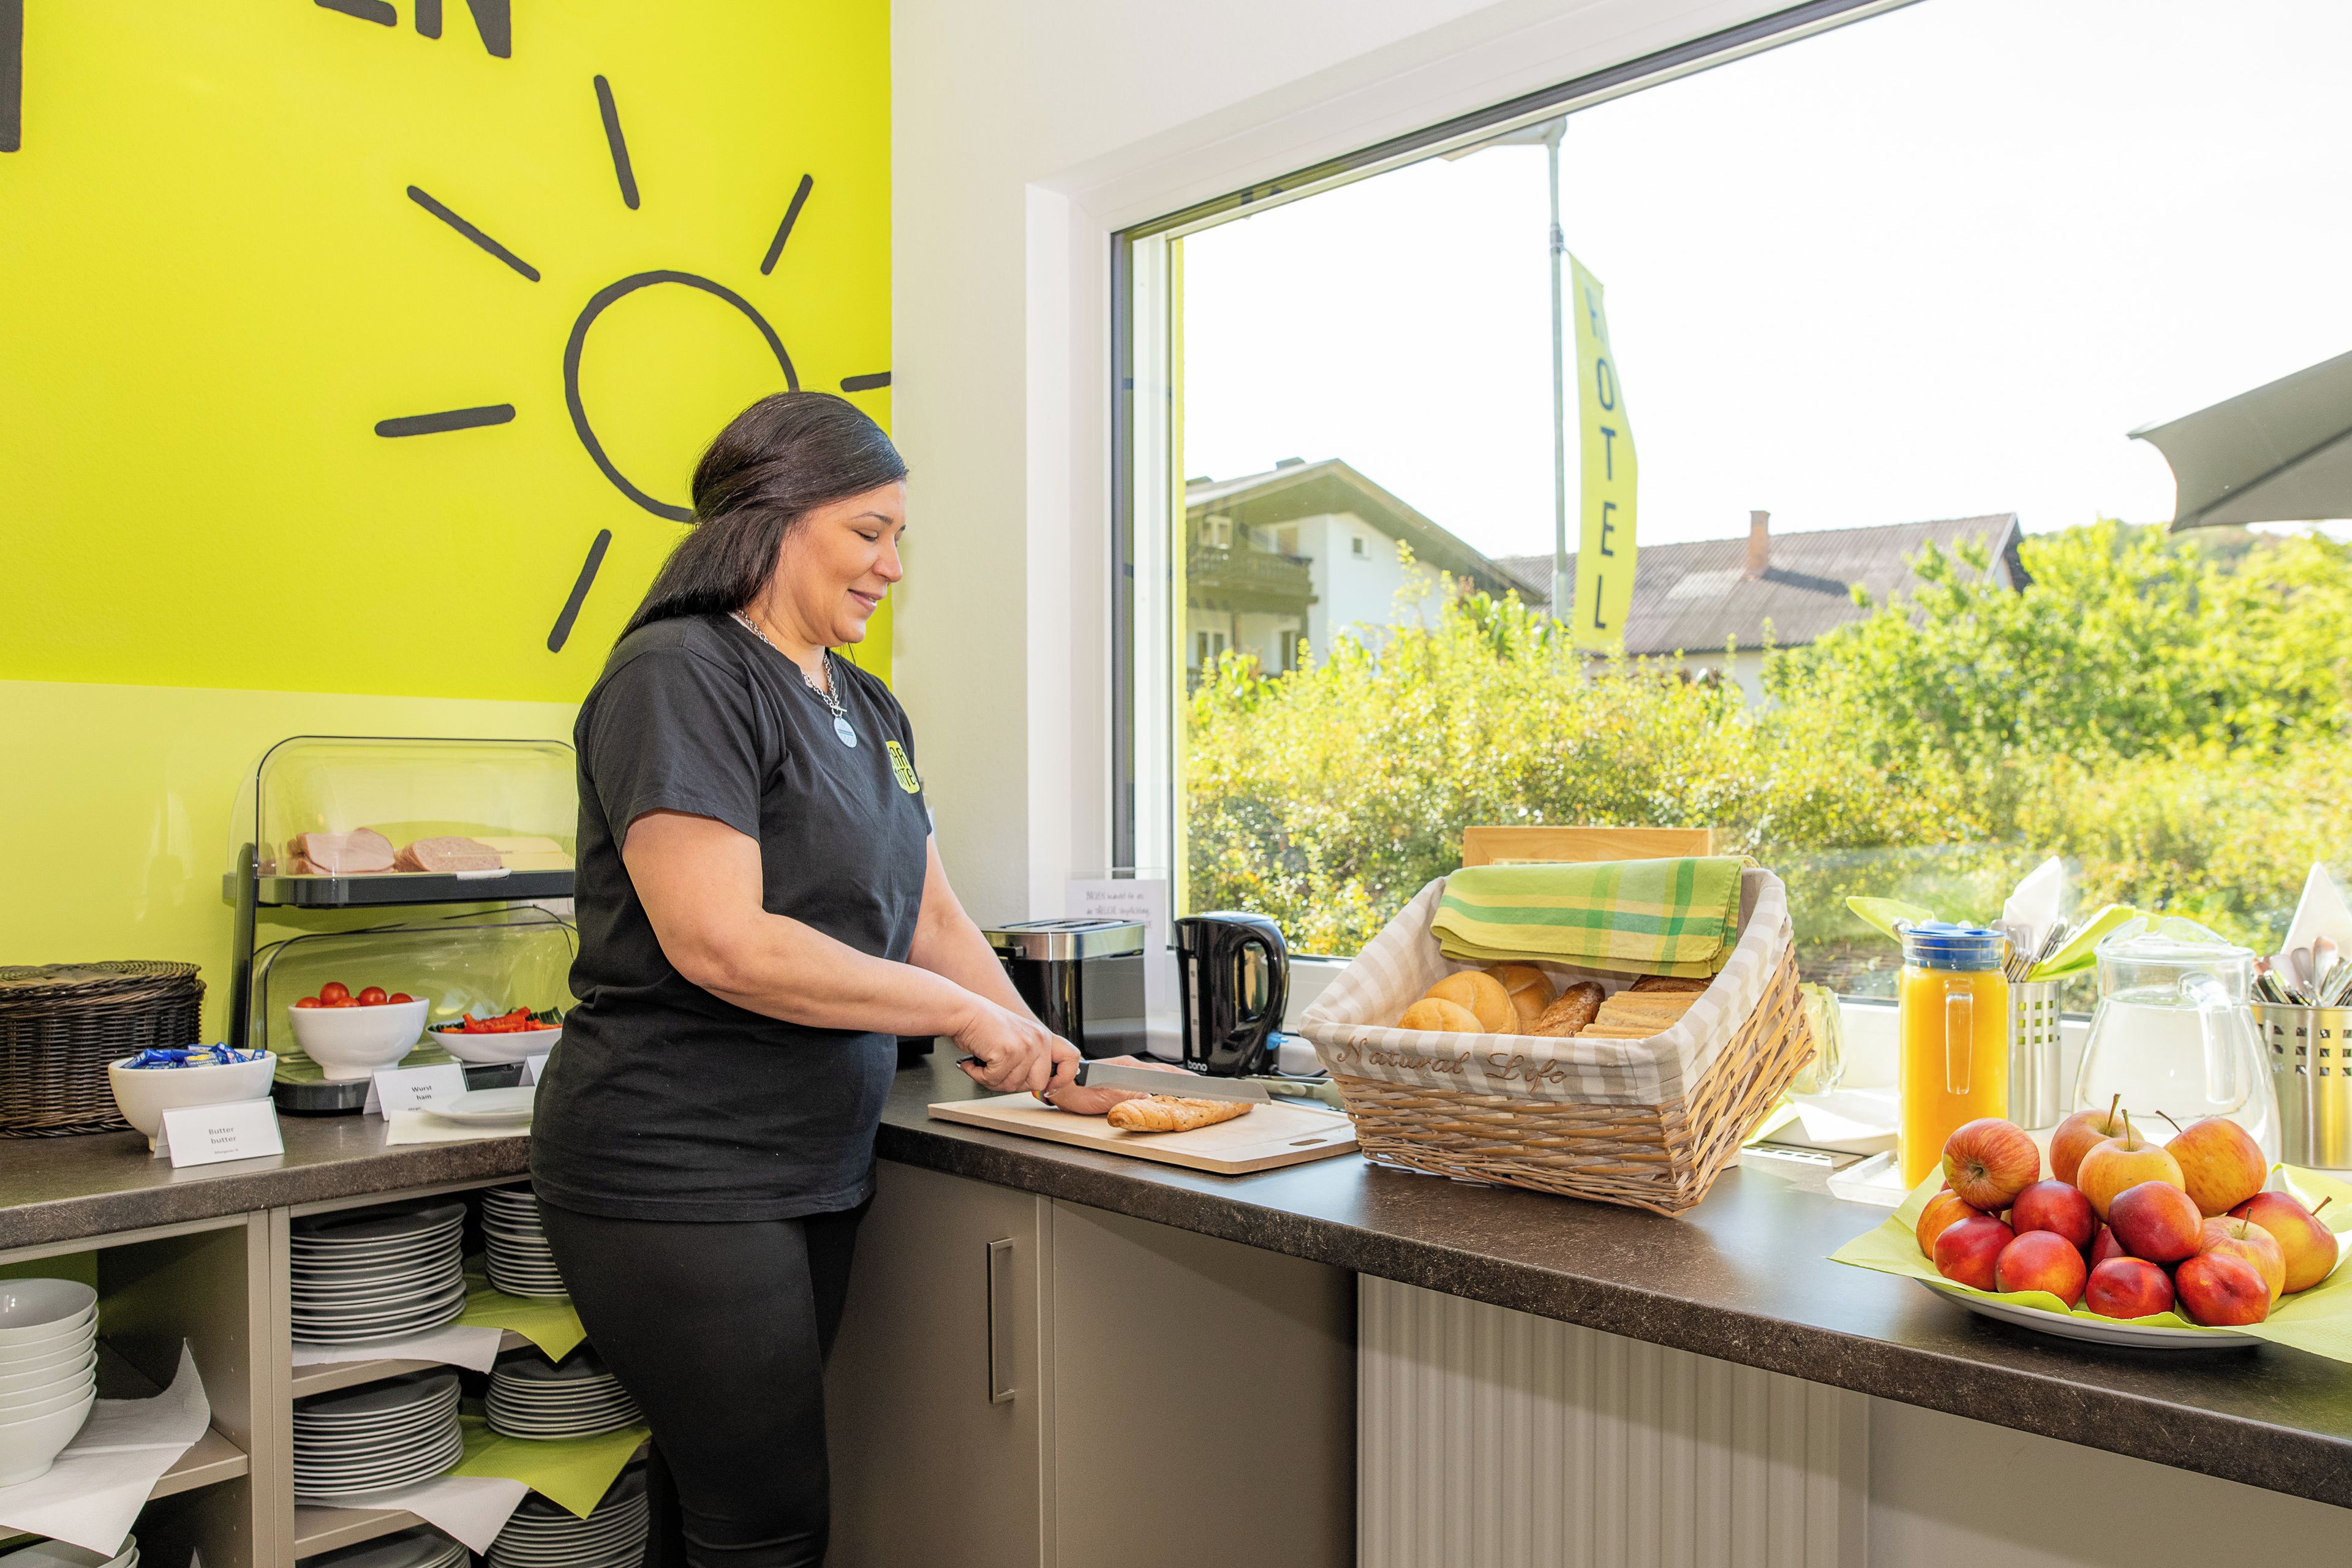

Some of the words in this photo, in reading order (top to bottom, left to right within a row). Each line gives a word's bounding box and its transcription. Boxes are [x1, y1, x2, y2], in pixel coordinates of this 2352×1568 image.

[1336, 1035, 1471, 1075] Natural
[1484, 1050, 1567, 1093] Life
[208, 1126, 235, 1136] Butter
